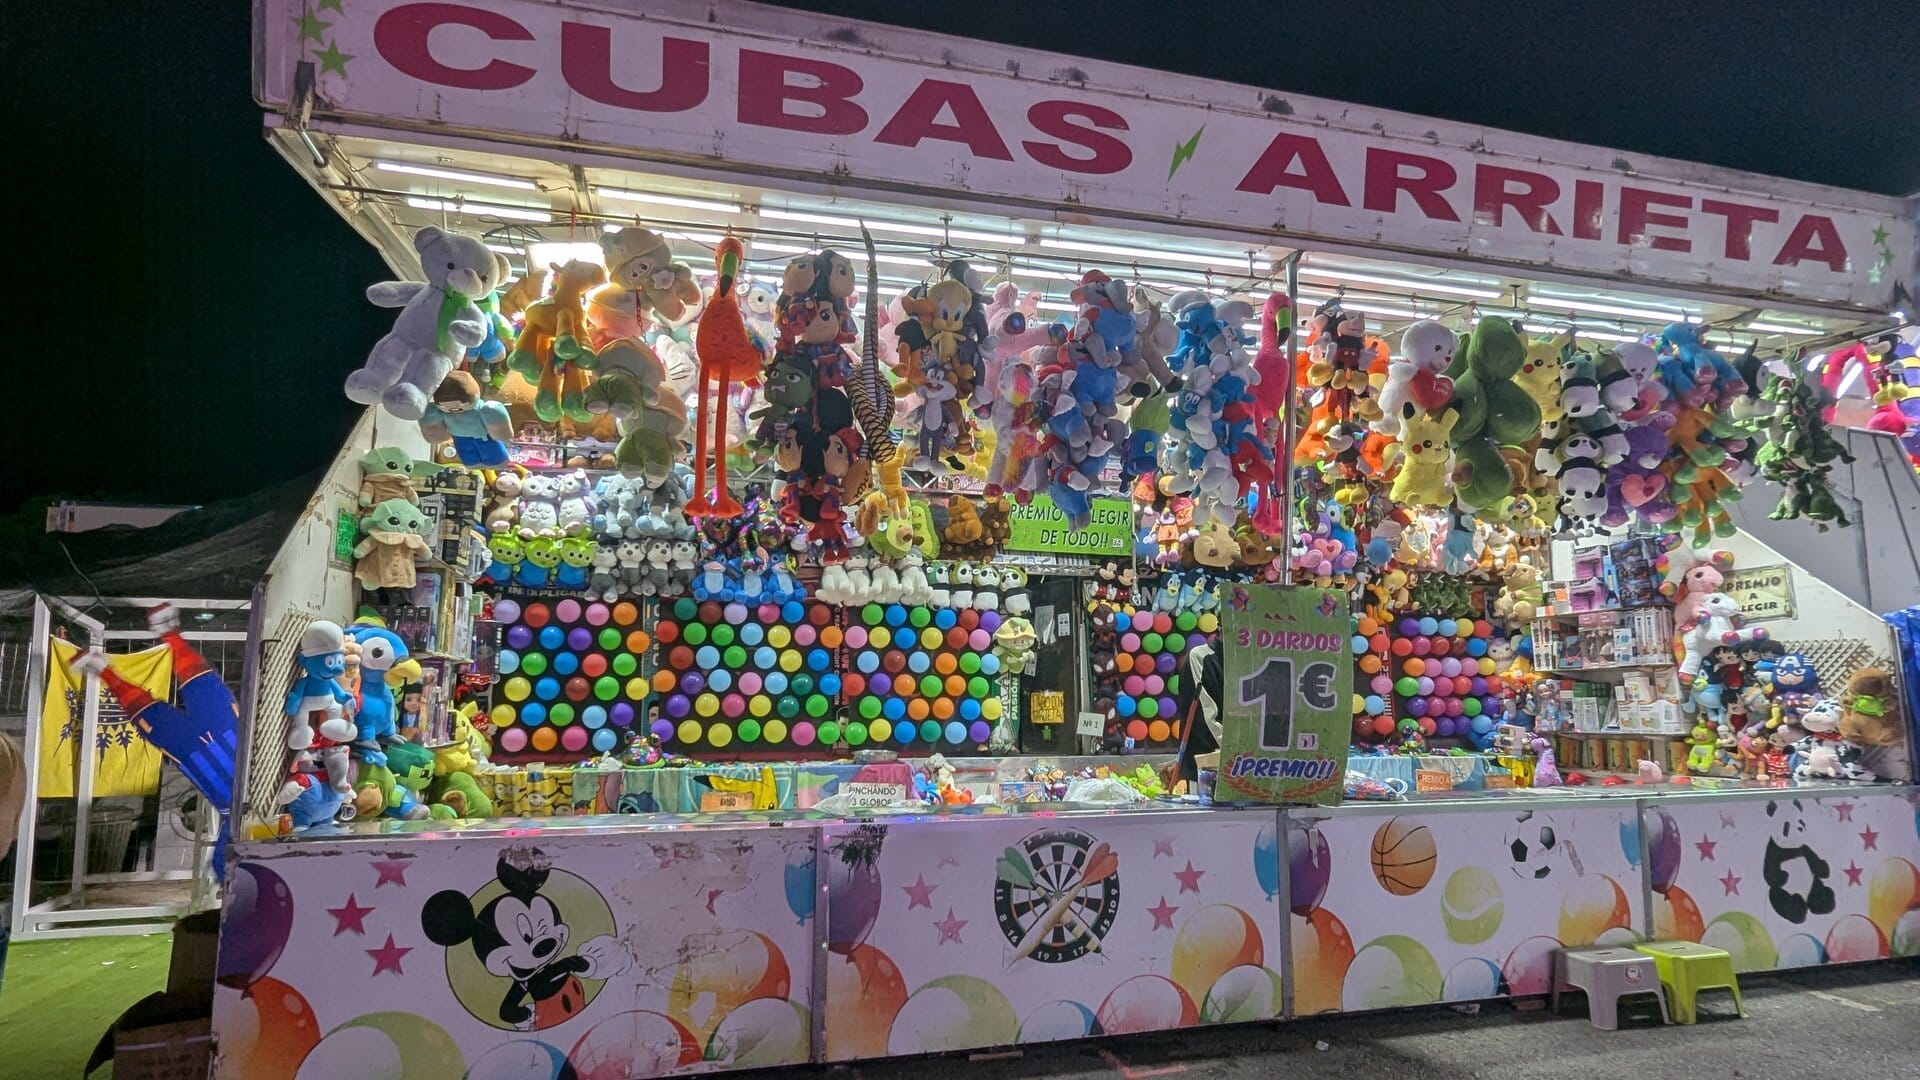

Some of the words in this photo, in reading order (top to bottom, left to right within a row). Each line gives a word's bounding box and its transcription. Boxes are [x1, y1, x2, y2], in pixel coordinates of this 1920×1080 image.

[374, 1, 1133, 174] CUBAS
[1235, 132, 1851, 272] ARRIETA
[1009, 503, 1063, 521] PREMIO
[1091, 508, 1129, 525] LEGIR
[1040, 529, 1058, 545] DE
[1062, 531, 1109, 547] TODO!!
[1726, 576, 1782, 592] PREMIO
[1741, 601, 1778, 612] LEGIR
[1236, 628, 1250, 648] 3
[1256, 629, 1343, 653] DARDOS
[1230, 755, 1337, 781] ¡PREMIO!!
[848, 786, 897, 796] PINCHANDO
